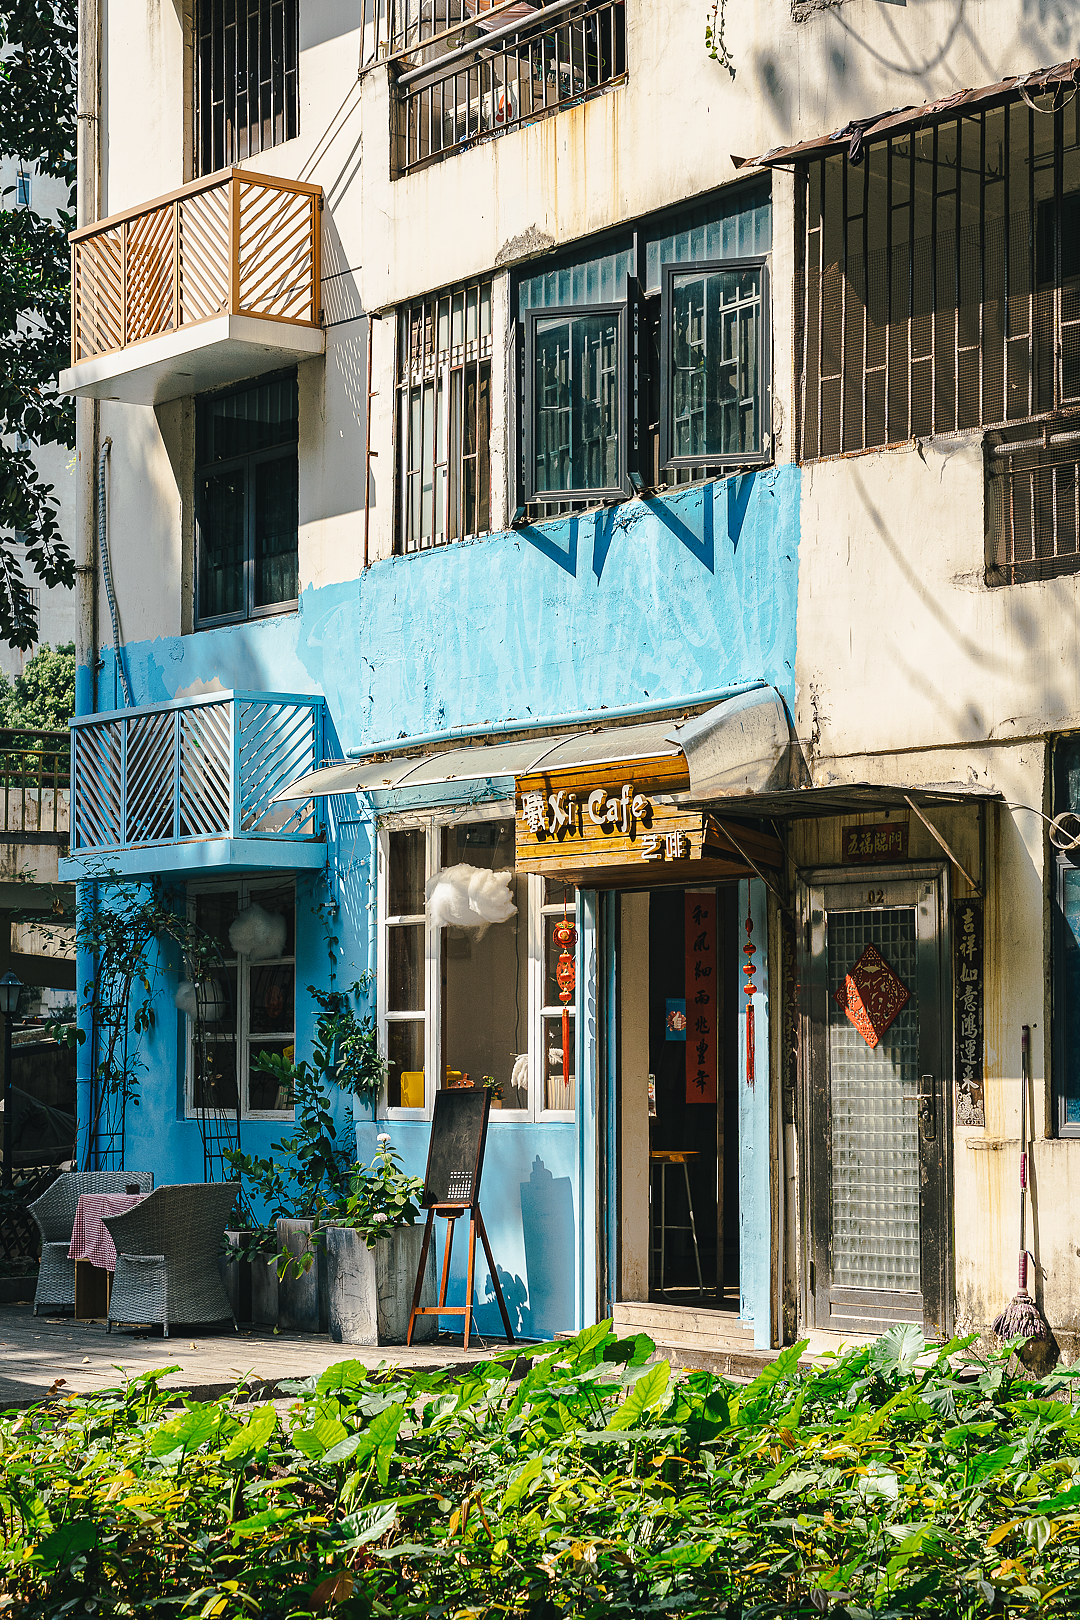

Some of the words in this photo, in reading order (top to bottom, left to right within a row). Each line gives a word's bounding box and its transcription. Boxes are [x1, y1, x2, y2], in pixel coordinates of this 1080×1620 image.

[549, 790, 577, 833] Xi
[588, 784, 648, 832] Cafe
[641, 829, 685, 859] 艺啡
[847, 830, 902, 855] 五福臨門
